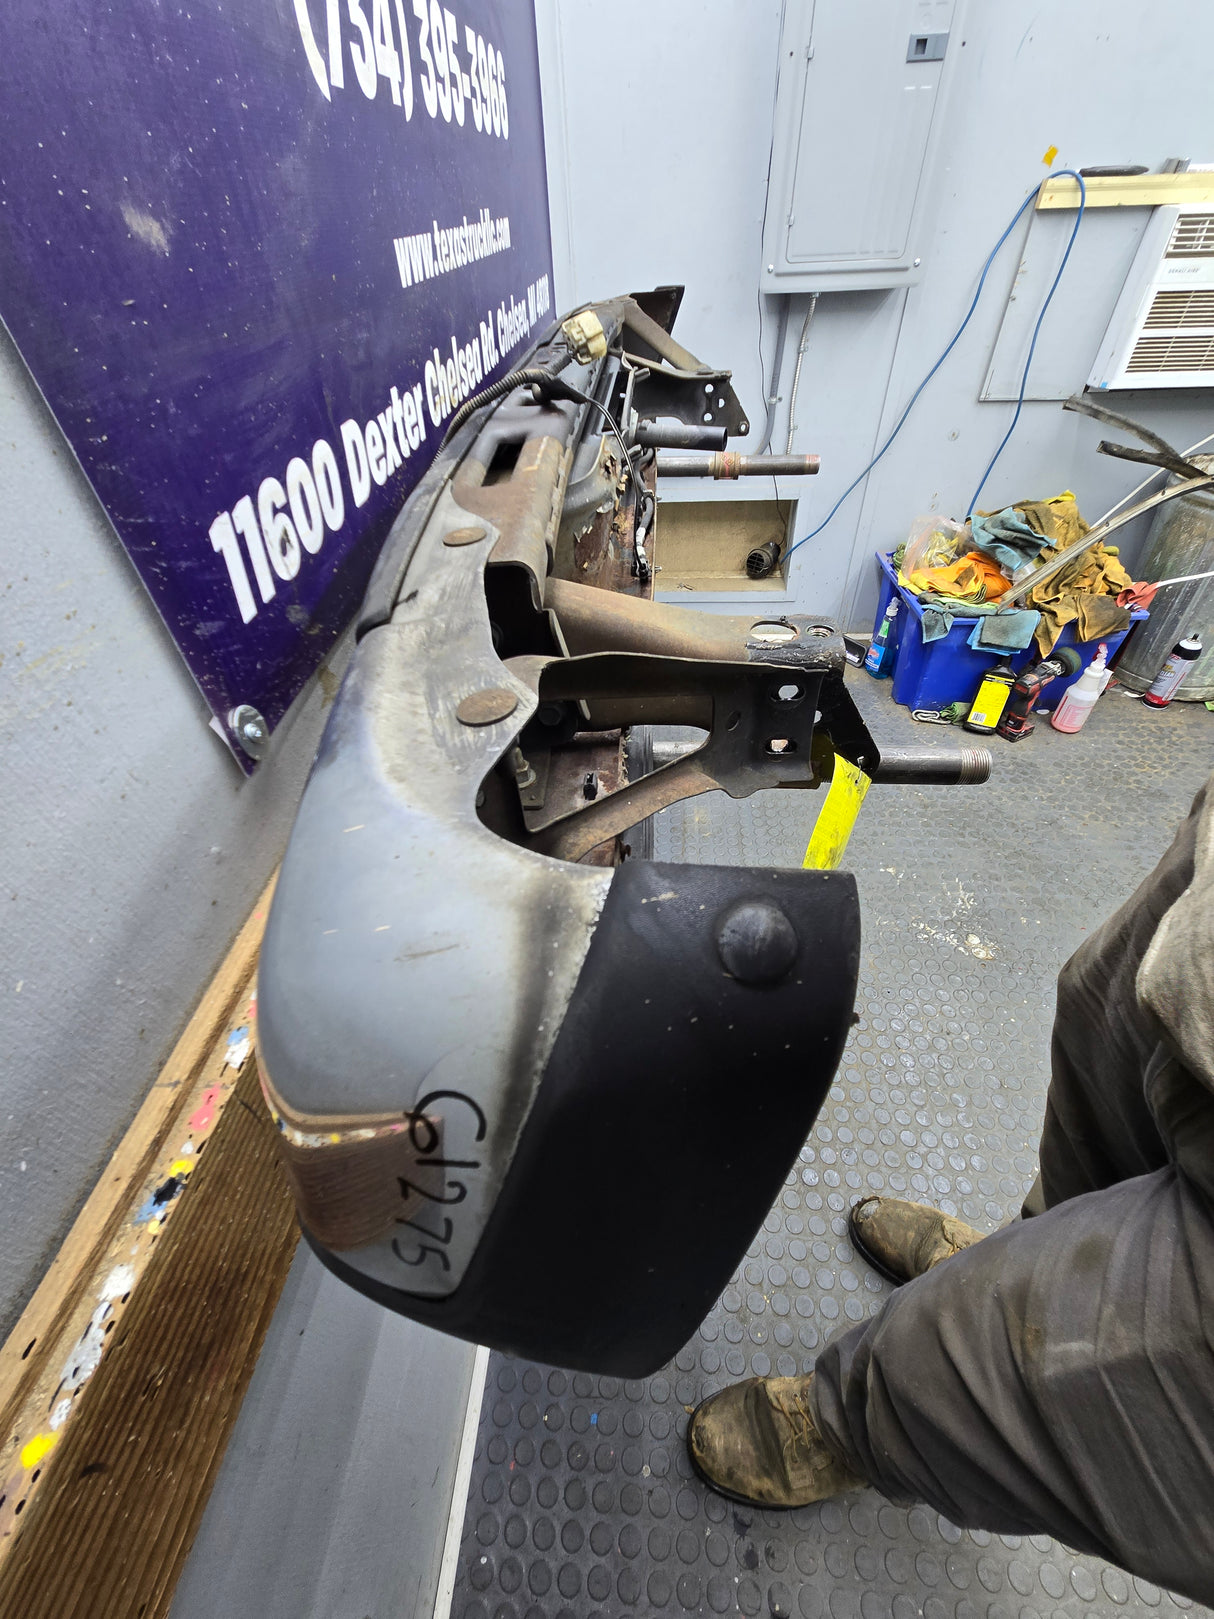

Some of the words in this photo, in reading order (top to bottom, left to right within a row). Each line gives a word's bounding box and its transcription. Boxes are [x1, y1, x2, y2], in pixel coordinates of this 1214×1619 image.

[412, 0, 508, 140] 395-3966
[393, 208, 511, 288] www.texastruckllc.com
[208, 439, 344, 624] 11600
[340, 382, 427, 508] Dexter
[424, 335, 483, 427] Chelsea
[479, 311, 500, 374] Rd.
[497, 294, 530, 358] Chelsea,
[527, 283, 537, 328] MI
